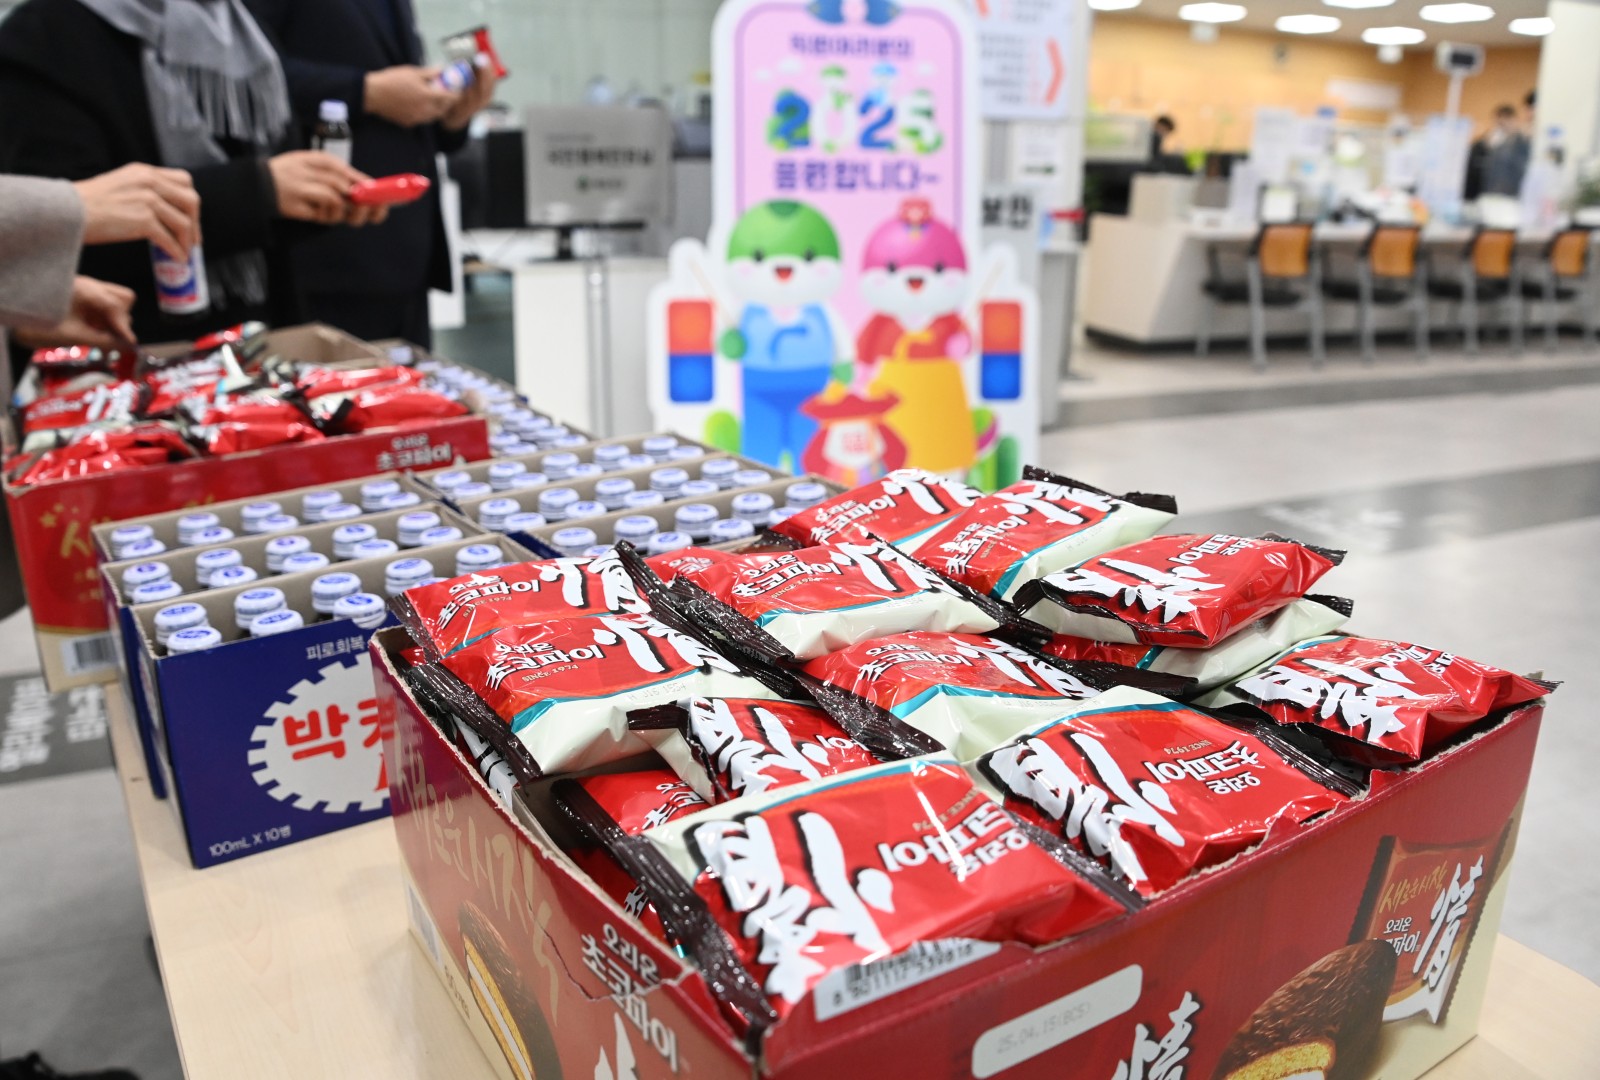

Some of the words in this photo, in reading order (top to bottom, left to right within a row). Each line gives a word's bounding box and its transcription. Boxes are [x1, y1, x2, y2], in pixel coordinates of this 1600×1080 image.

[768, 87, 945, 153] 2025
[377, 441, 452, 471] 초코파이
[810, 494, 897, 546] 초코파이
[815, 500, 858, 522] 오리온
[944, 514, 1029, 575] 초코파이
[732, 563, 842, 597] 초코파이
[749, 553, 798, 578] 오리온
[771, 583, 796, 598] SINCE
[865, 643, 924, 657] 오리온
[485, 643, 605, 691] 초코파이
[522, 670, 551, 681] SINCE
[553, 663, 579, 674] 1974
[853, 651, 973, 683] 초코파이
[1143, 739, 1265, 785] 초코파이
[1164, 745, 1190, 755] 1974
[1205, 771, 1261, 795] 오리온
[209, 837, 251, 858] 100mL
[877, 801, 1018, 873] 코파이
[1383, 917, 1412, 934] 오리온
[603, 923, 662, 985] 오리온
[580, 933, 678, 1073] 초코파이
